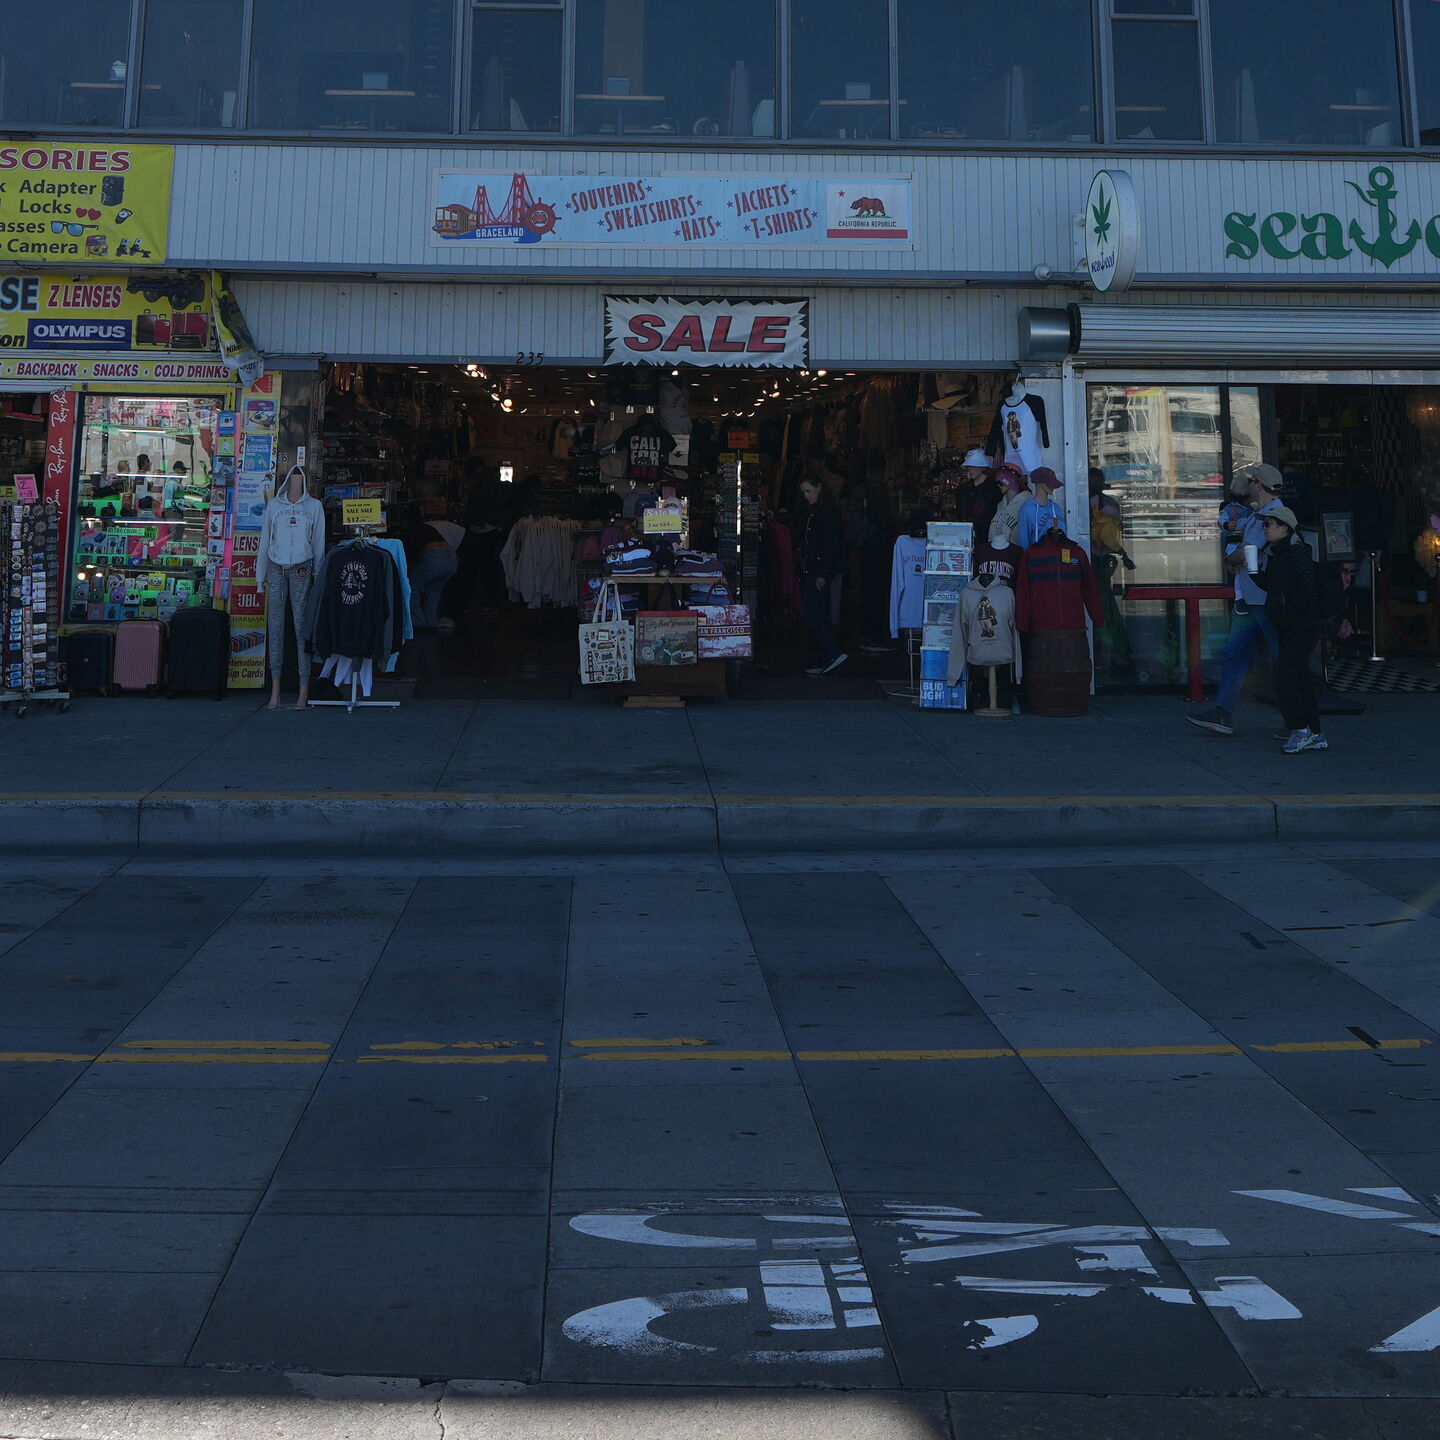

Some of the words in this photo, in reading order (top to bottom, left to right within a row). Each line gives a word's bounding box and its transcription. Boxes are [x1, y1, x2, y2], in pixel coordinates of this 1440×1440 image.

[19, 180, 96, 199] Adapter
[570, 179, 646, 213] SOUVENIRS
[20, 199, 72, 214] Locks
[734, 184, 791, 217] JACKETS
[605, 194, 697, 233] SWEATSHIRTS
[680, 215, 716, 242] HATS
[750, 207, 812, 239] T-SHIRTS
[838, 220, 870, 228] CALIFORNIA
[871, 220, 897, 228] REPUBLIC
[475, 227, 524, 239] GRACELAND
[7, 238, 79, 254] Camera
[48, 287, 60, 306] Z
[62, 288, 122, 309] LENSES
[33, 323, 126, 340] OLYMPUS
[623, 313, 791, 353] SALE
[516, 352, 544, 365] 235
[16, 362, 78, 376] BACKPACK
[92, 363, 139, 378] SNACKS
[154, 364, 187, 378] COLD
[187, 365, 229, 379] DRINKS
[238, 593, 260, 608] JBL
[710, 626, 745, 634] FRANCISCO
[229, 658, 264, 668] nternational
[242, 668, 264, 679] Cards
[923, 682, 943, 692] BUD
